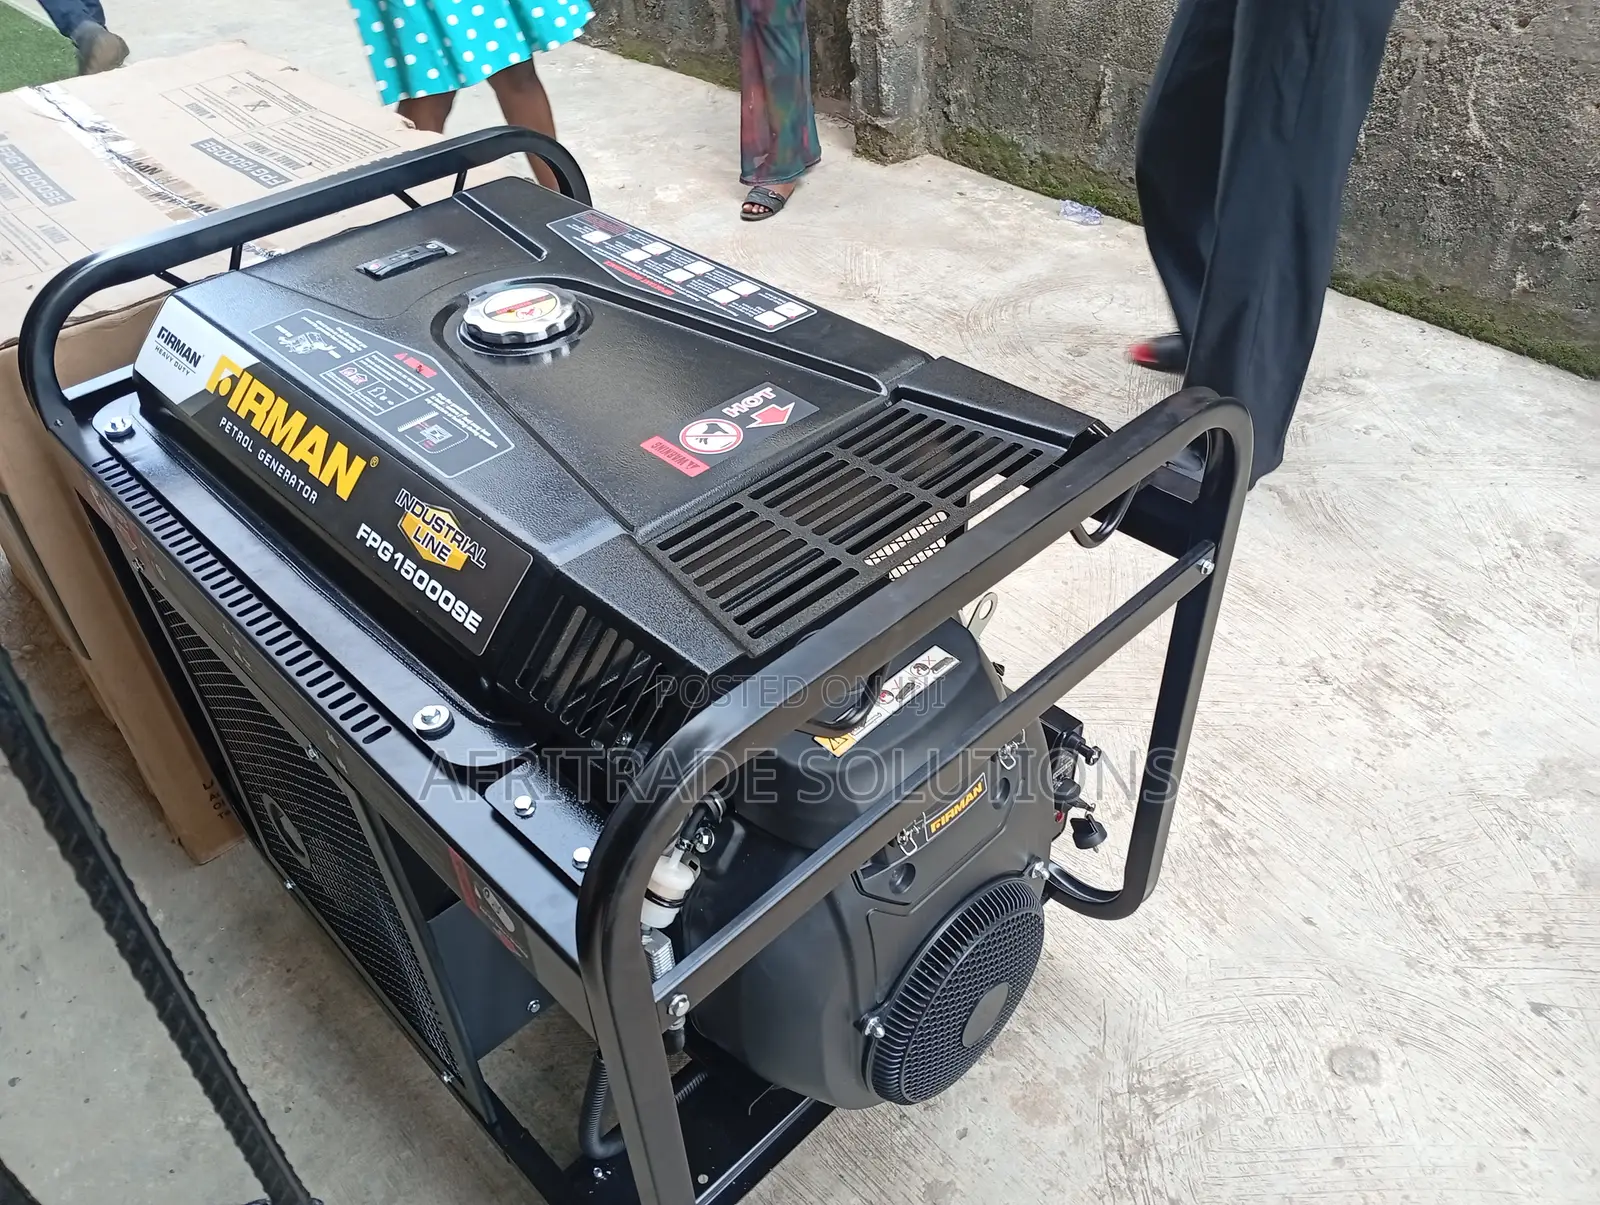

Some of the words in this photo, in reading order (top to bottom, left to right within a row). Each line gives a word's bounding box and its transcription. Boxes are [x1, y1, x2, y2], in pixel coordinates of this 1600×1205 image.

[199, 140, 286, 186] FPG15000SE
[154, 345, 175, 365] HEAVY
[174, 360, 194, 377] DUTY
[156, 325, 202, 368] FIRMAN
[721, 386, 778, 418] HOT
[205, 354, 368, 502] FIRMAN
[218, 416, 254, 453] PETROL
[257, 449, 319, 505] GENERATOR
[650, 441, 690, 468] WARNING
[394, 488, 487, 569] INDUSTRIAL
[412, 526, 452, 564] LINE
[356, 522, 484, 635] FPG15000SE
[929, 781, 983, 834] FIRMAN
